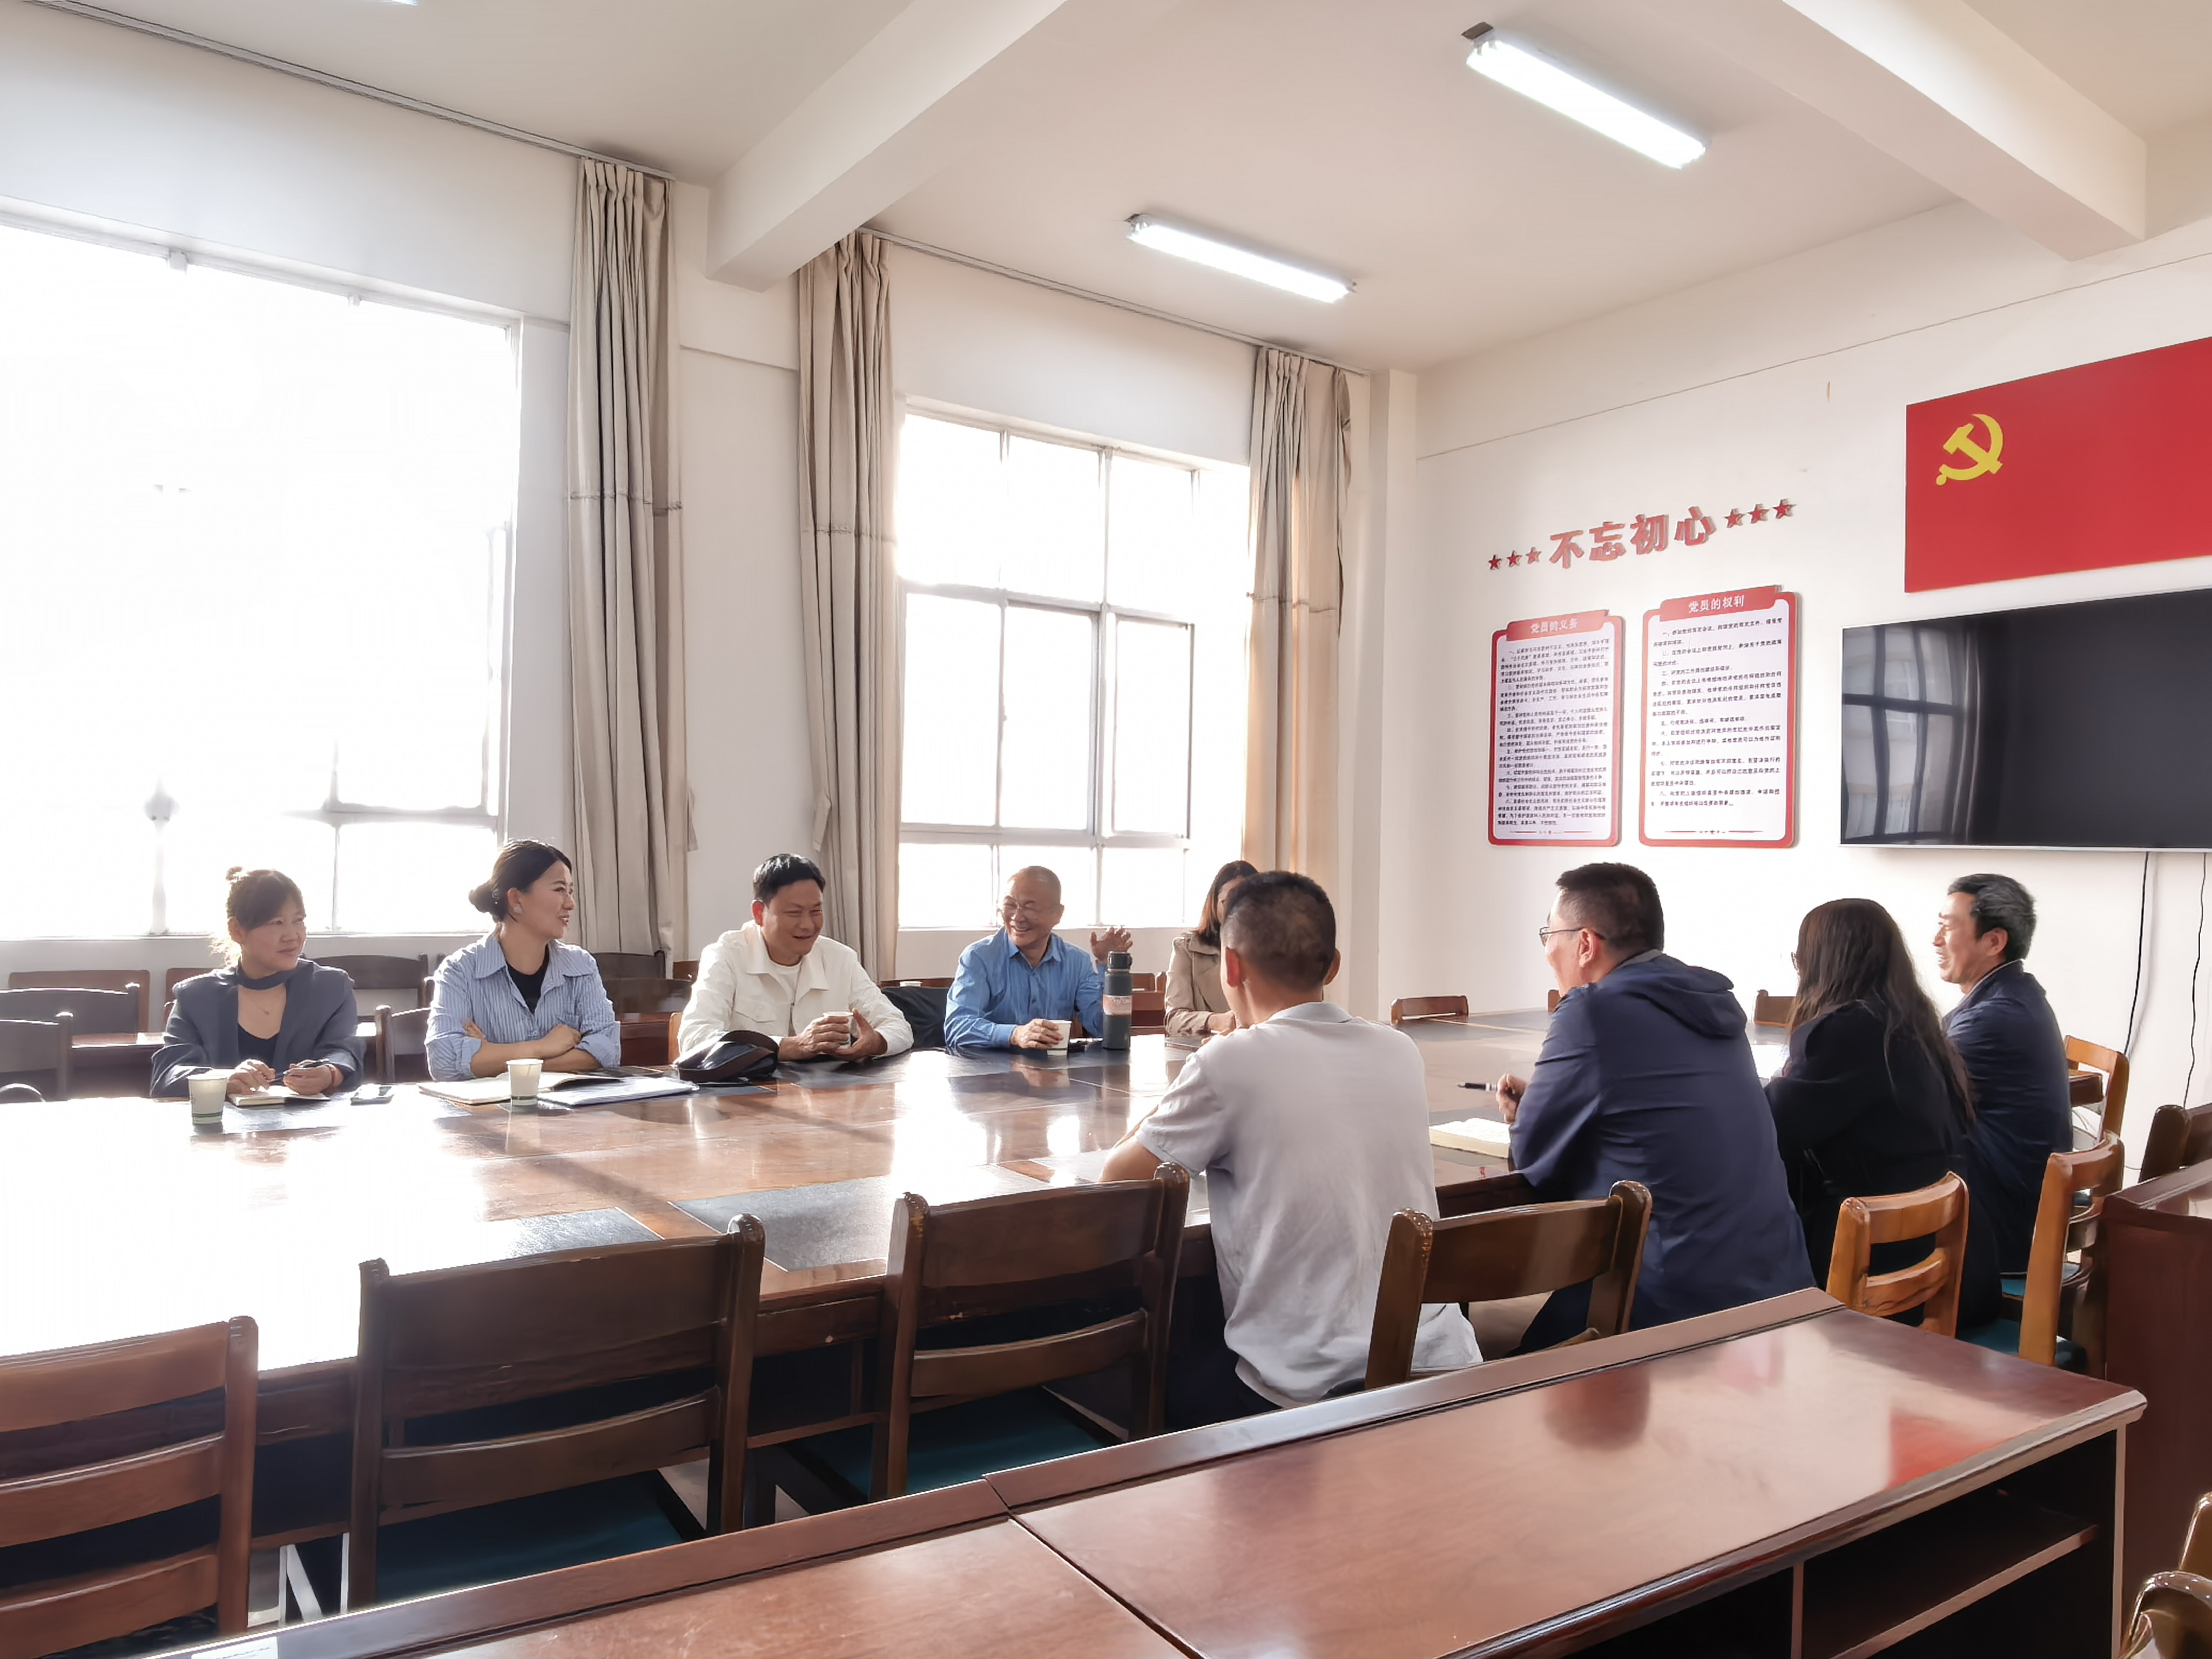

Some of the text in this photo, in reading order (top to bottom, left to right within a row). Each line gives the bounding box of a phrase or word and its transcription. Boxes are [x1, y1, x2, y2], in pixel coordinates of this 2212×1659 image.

[1549, 506, 1716, 569] 不忘初心
[1688, 595, 1745, 613] 党员的权利
[1530, 618, 1578, 634] 党员的义务
